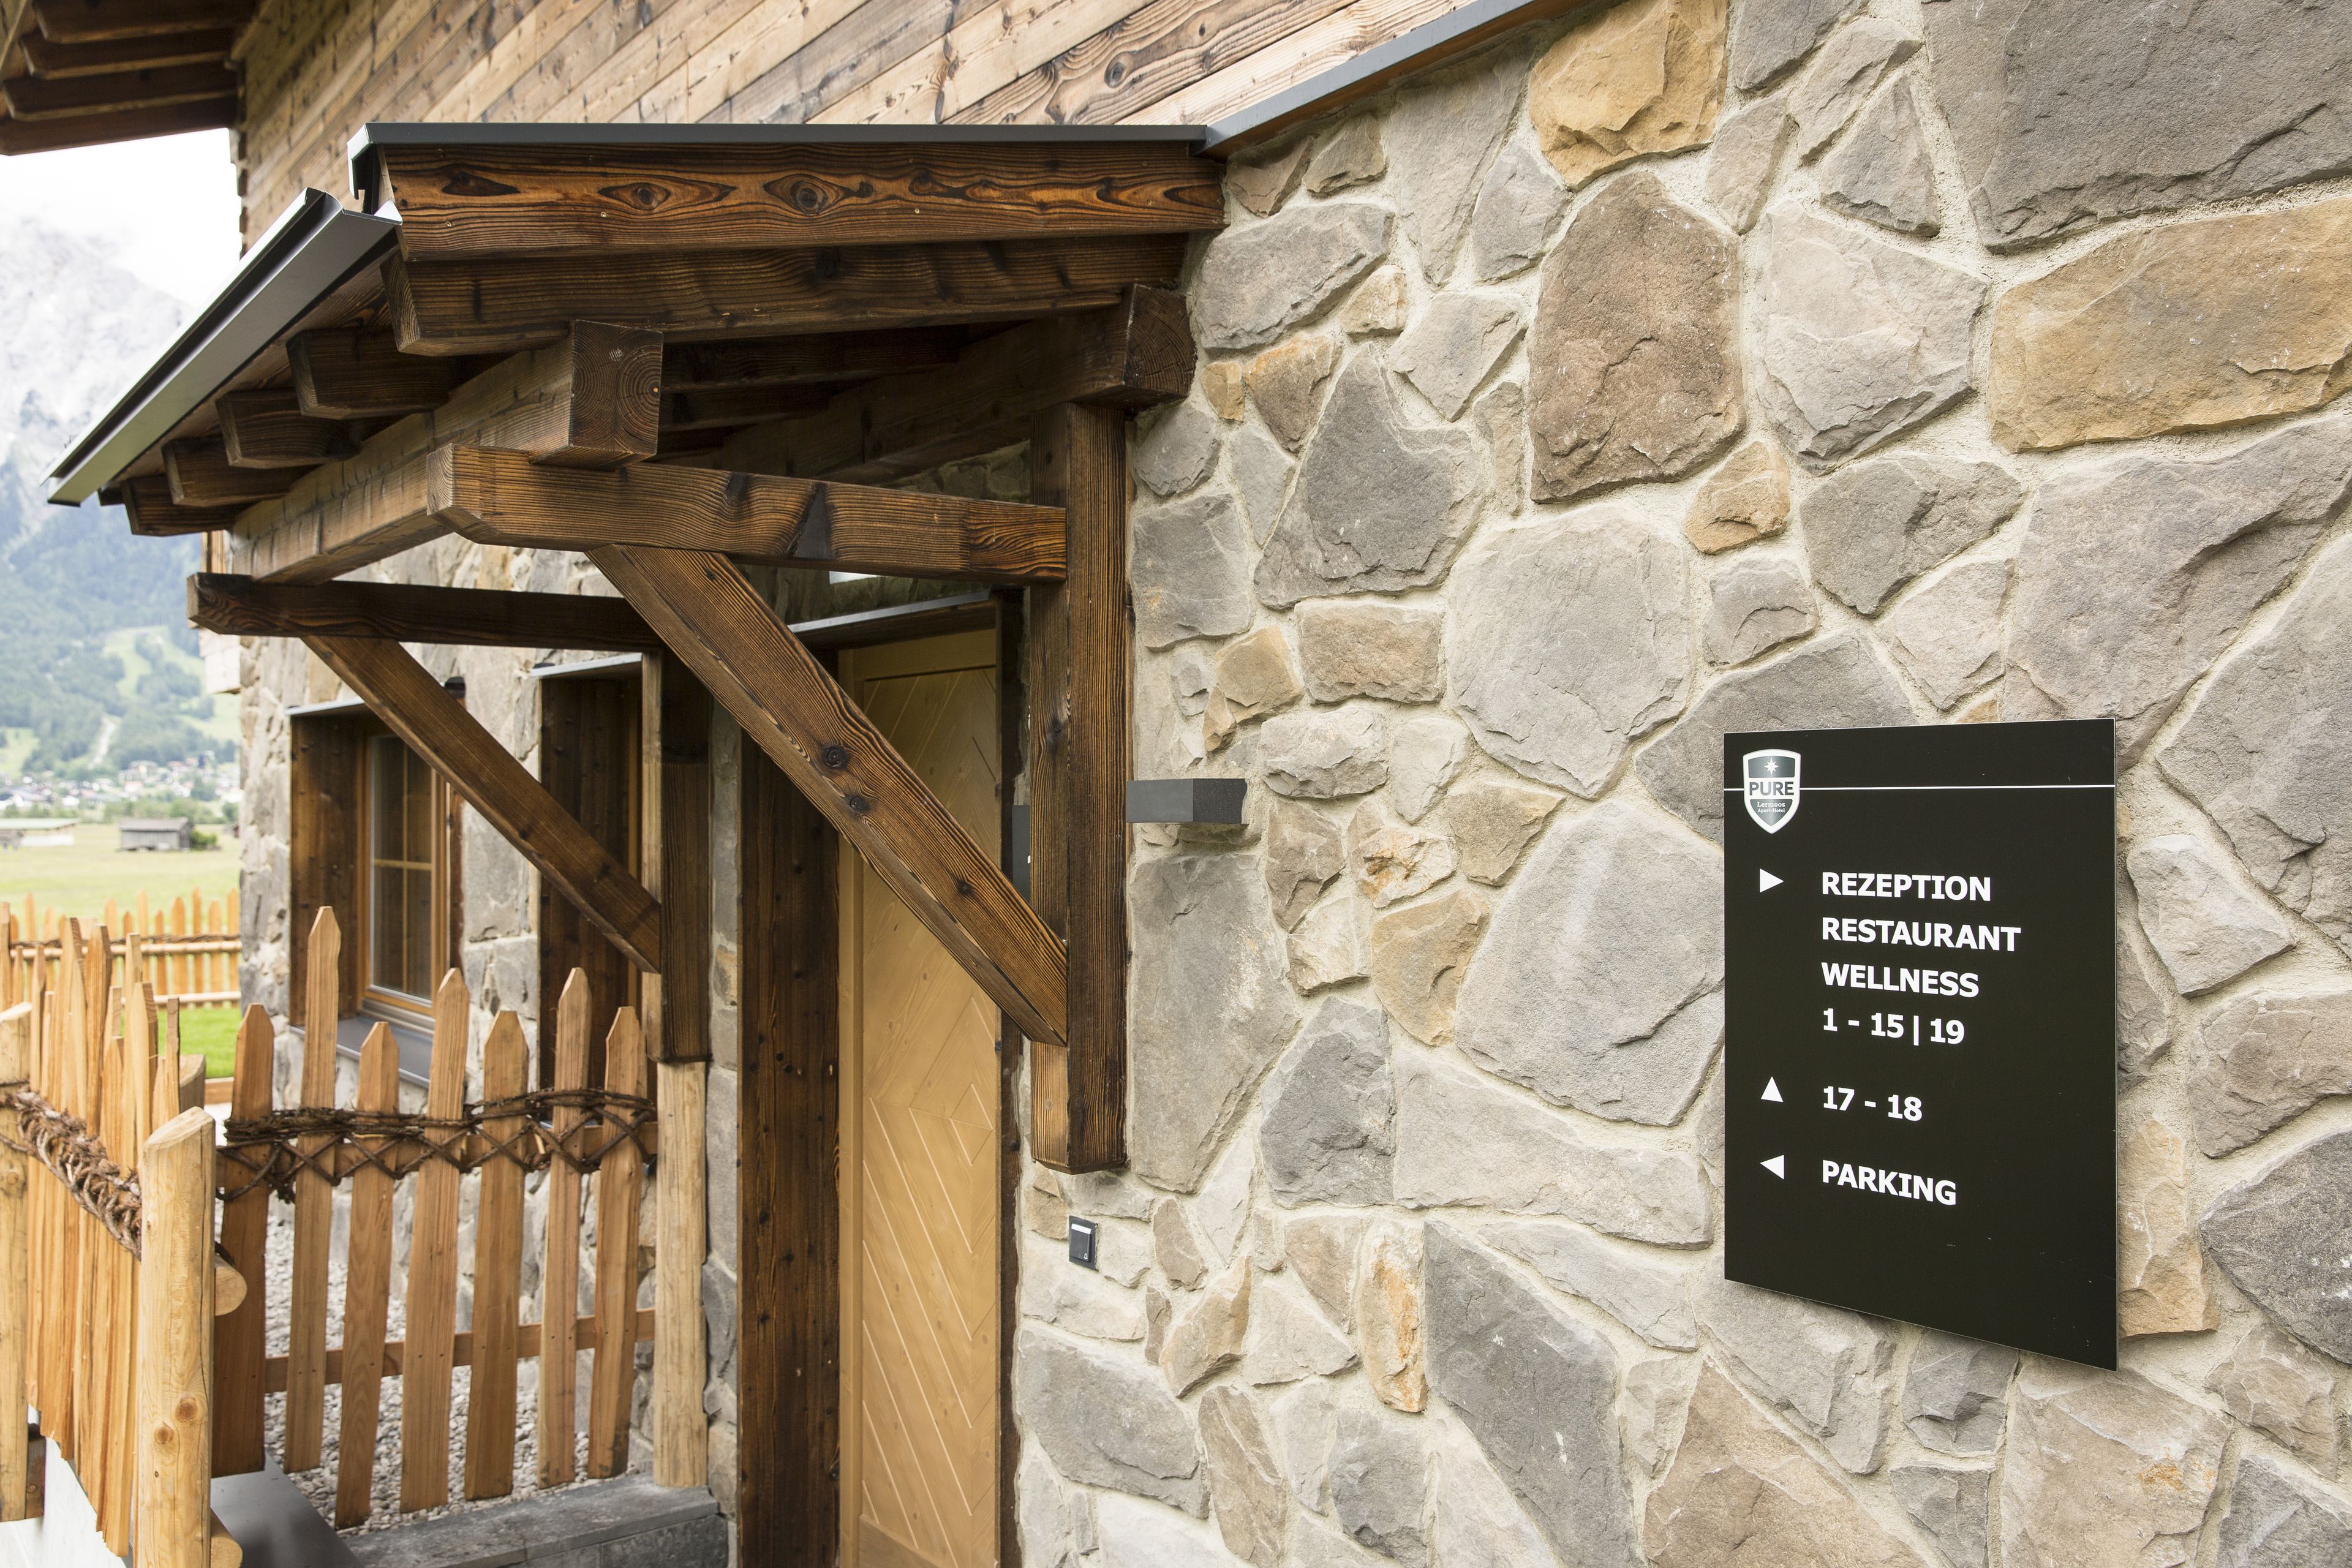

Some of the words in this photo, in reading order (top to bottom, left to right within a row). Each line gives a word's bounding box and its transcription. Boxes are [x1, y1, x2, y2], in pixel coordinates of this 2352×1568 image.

[1749, 781, 1794, 796] PURE
[1822, 872, 1991, 902] REZEPTION
[1822, 917, 2021, 952] RESTAURANT
[1821, 962, 1980, 998] WELLNESS
[1823, 1008, 1838, 1031] 1
[1823, 1085, 1855, 1111] 17
[1888, 1094, 1923, 1121] 18
[1822, 1159, 1956, 1205] PARKING
